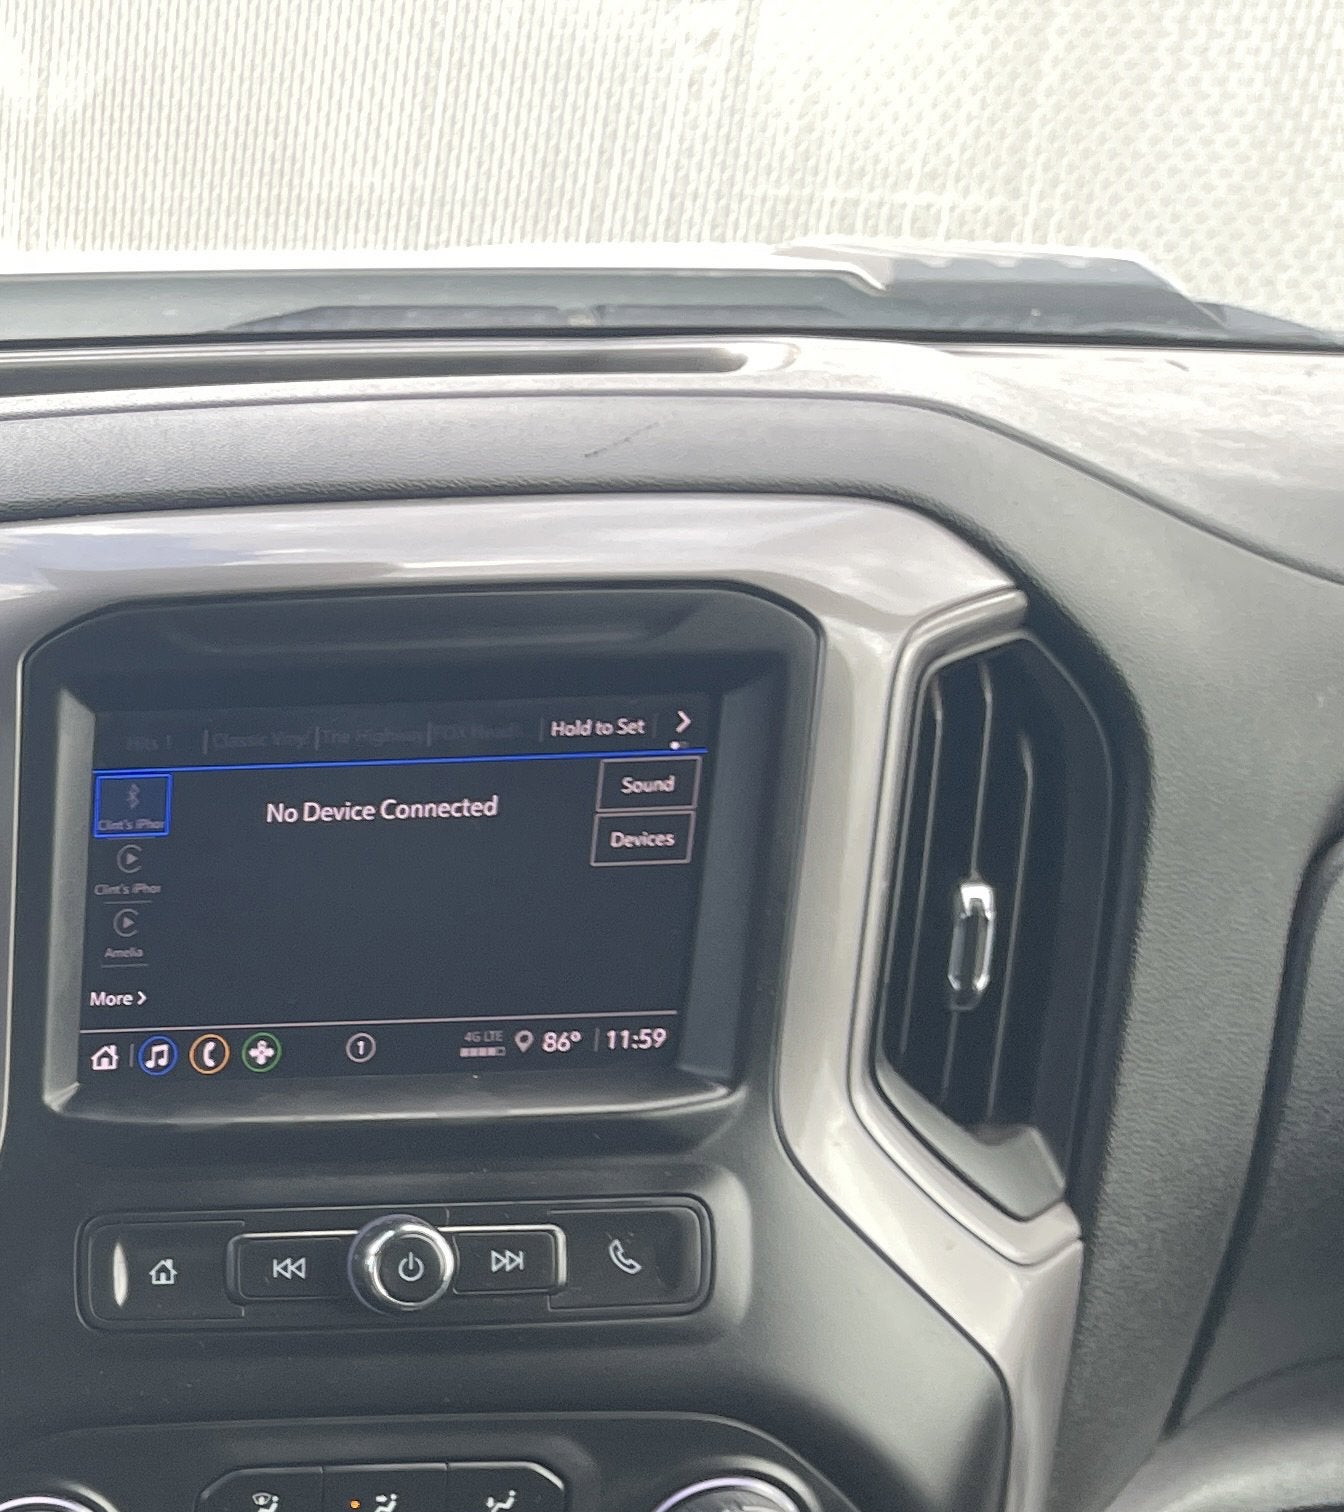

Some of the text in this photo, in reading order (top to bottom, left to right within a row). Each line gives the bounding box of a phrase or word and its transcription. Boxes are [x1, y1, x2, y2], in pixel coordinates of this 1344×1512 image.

[550, 719, 591, 737] Hold
[595, 721, 613, 736] to
[616, 717, 645, 735] Set
[620, 775, 675, 794] Sound
[266, 795, 499, 823] No Device Connected
[610, 832, 675, 849] Devices
[103, 947, 144, 958] Amelia
[89, 991, 134, 1007] More
[464, 1030, 503, 1042] 4G LTE
[606, 1028, 668, 1050] 11:59
